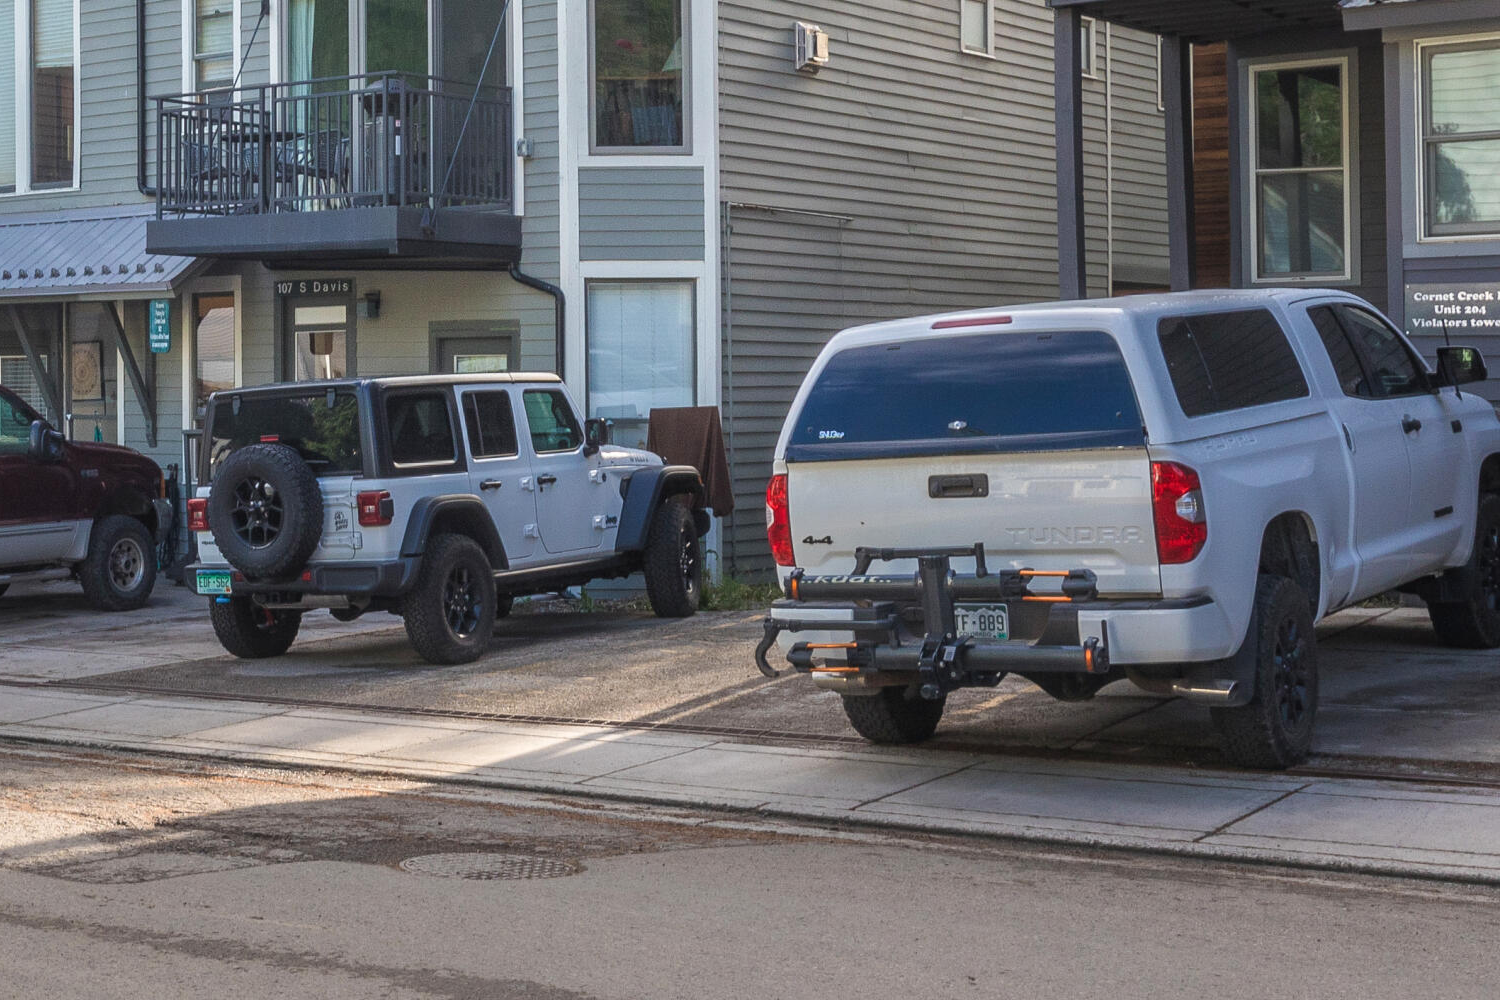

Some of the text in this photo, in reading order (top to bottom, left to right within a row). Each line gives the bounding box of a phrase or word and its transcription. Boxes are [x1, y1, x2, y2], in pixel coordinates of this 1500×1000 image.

[277, 280, 349, 294] 107 S Davis
[1413, 292, 1455, 301] Cornet
[1457, 291, 1494, 301] Creek
[1434, 305, 1486, 315] Unit 204
[1412, 318, 1467, 328] Violators
[802, 535, 833, 545] 4x4
[1005, 526, 1145, 545] TUNDRA
